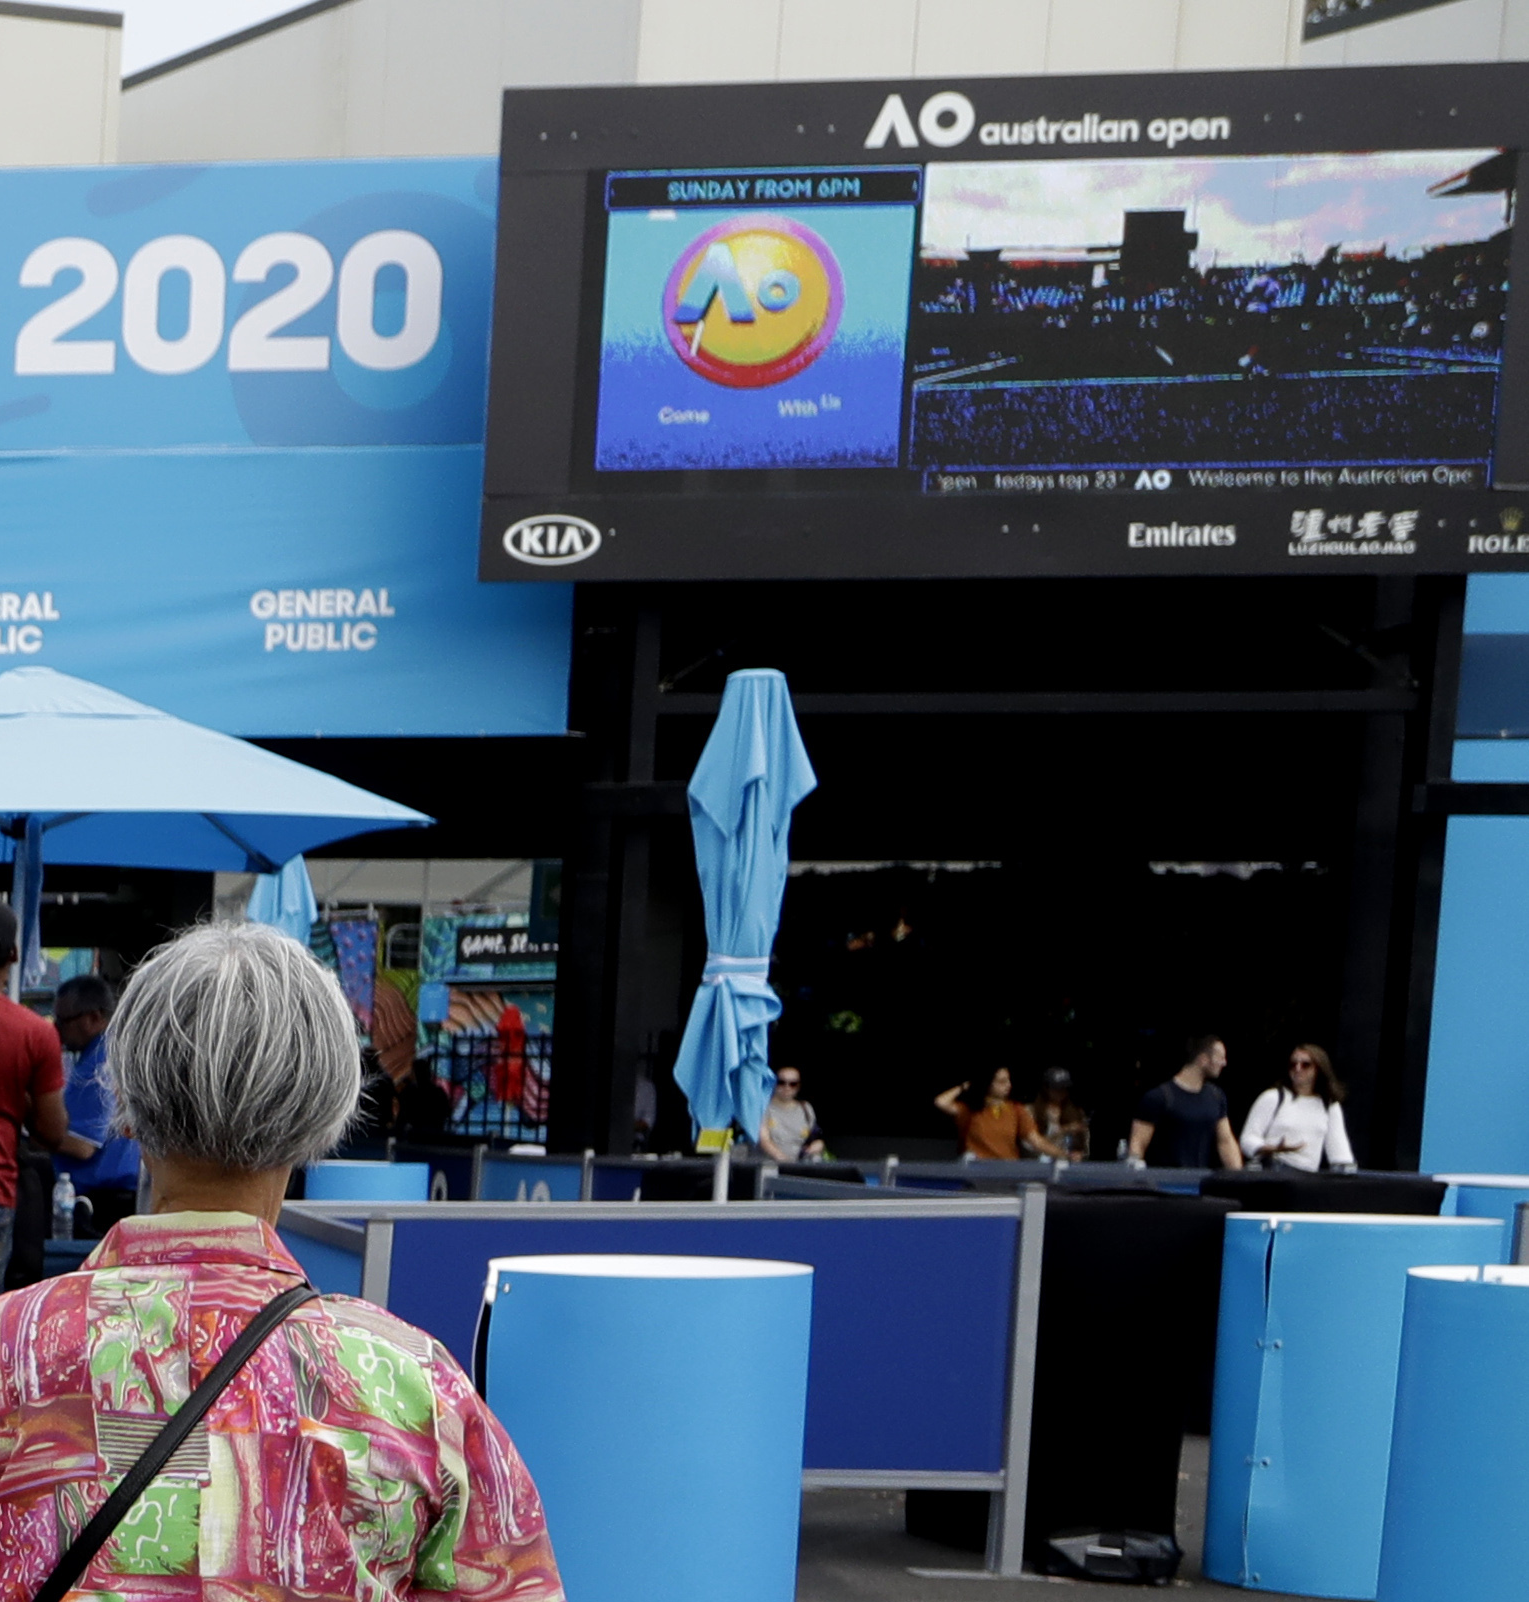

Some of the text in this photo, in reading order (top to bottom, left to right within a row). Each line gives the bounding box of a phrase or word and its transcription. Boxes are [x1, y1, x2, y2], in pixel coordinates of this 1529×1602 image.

[864, 91, 1231, 149] AO australian open
[667, 176, 861, 201] SUNDAY FROM 6PM
[14, 229, 444, 375] 2020
[1133, 469, 1172, 490] AO
[1188, 469, 1276, 487] Welcome
[520, 525, 585, 555] KIA
[1126, 520, 1237, 548] Emirates
[249, 589, 395, 620] GENERAL
[264, 622, 377, 651] PUBLIC
